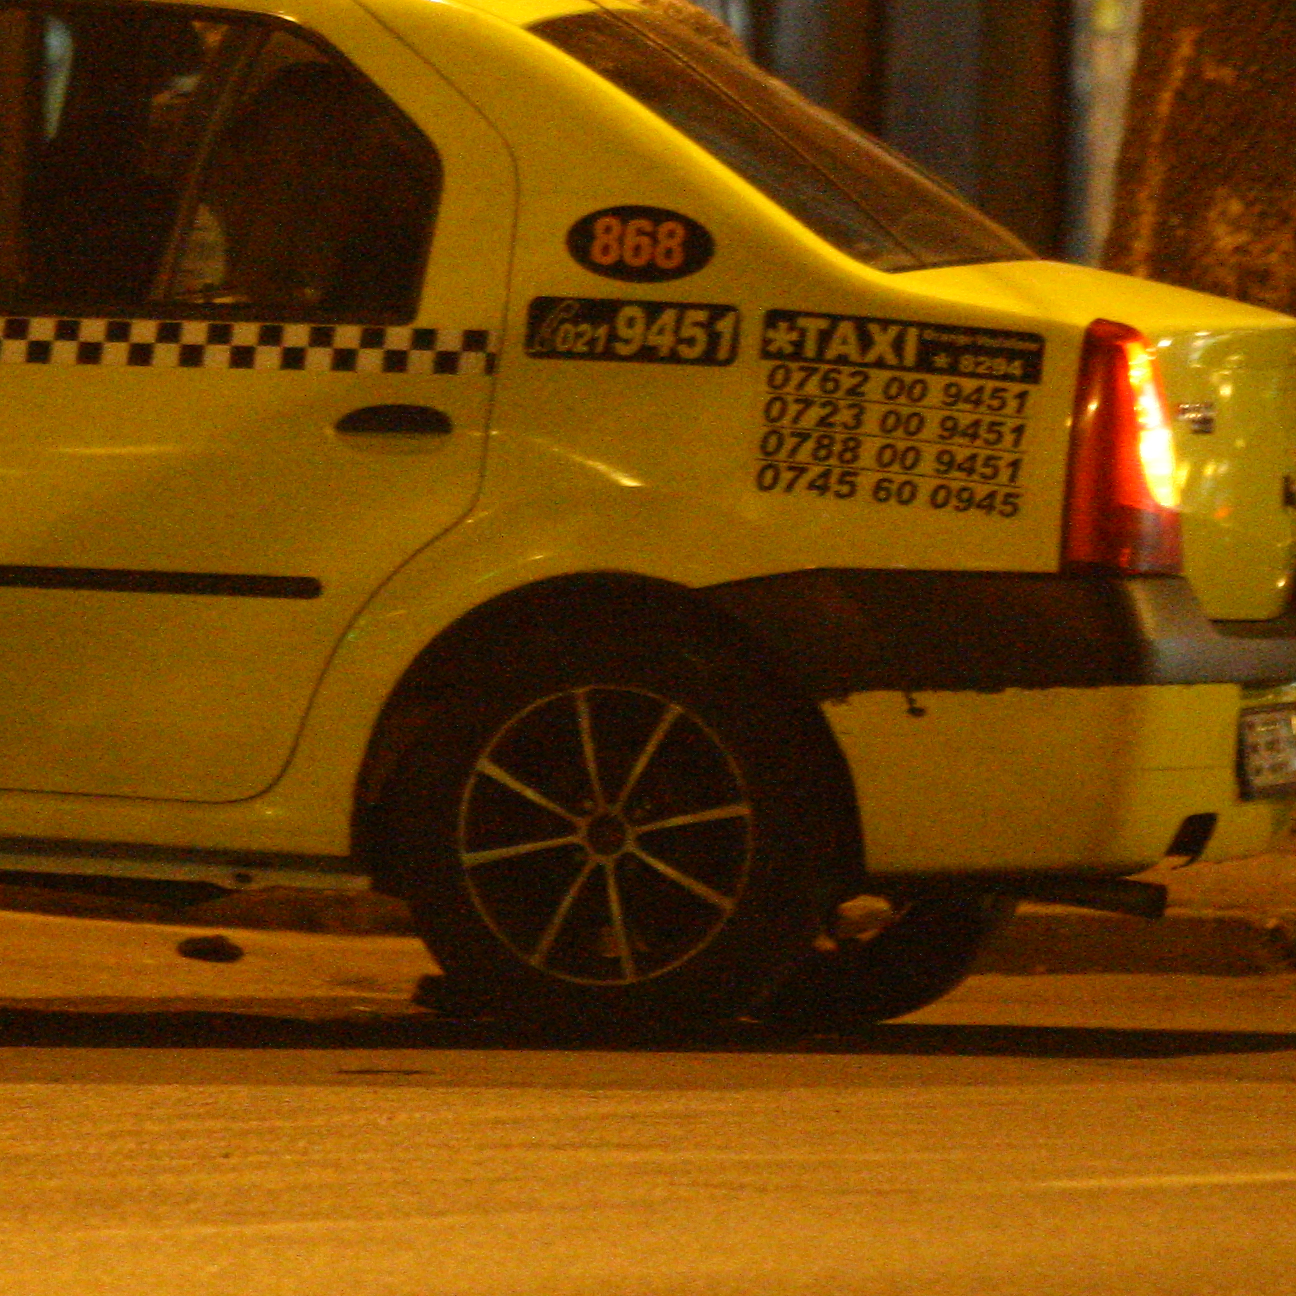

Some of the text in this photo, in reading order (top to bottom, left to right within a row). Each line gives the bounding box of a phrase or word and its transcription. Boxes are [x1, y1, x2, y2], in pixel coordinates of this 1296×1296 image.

[590, 214, 686, 270] 868
[555, 305, 739, 362] 021 9451
[766, 363, 1031, 415] 0762 00 9451
[763, 396, 1027, 450] 0723 00 9451
[759, 429, 1024, 485] 0788 00 9451
[756, 462, 1024, 519] 0745 60 0945
